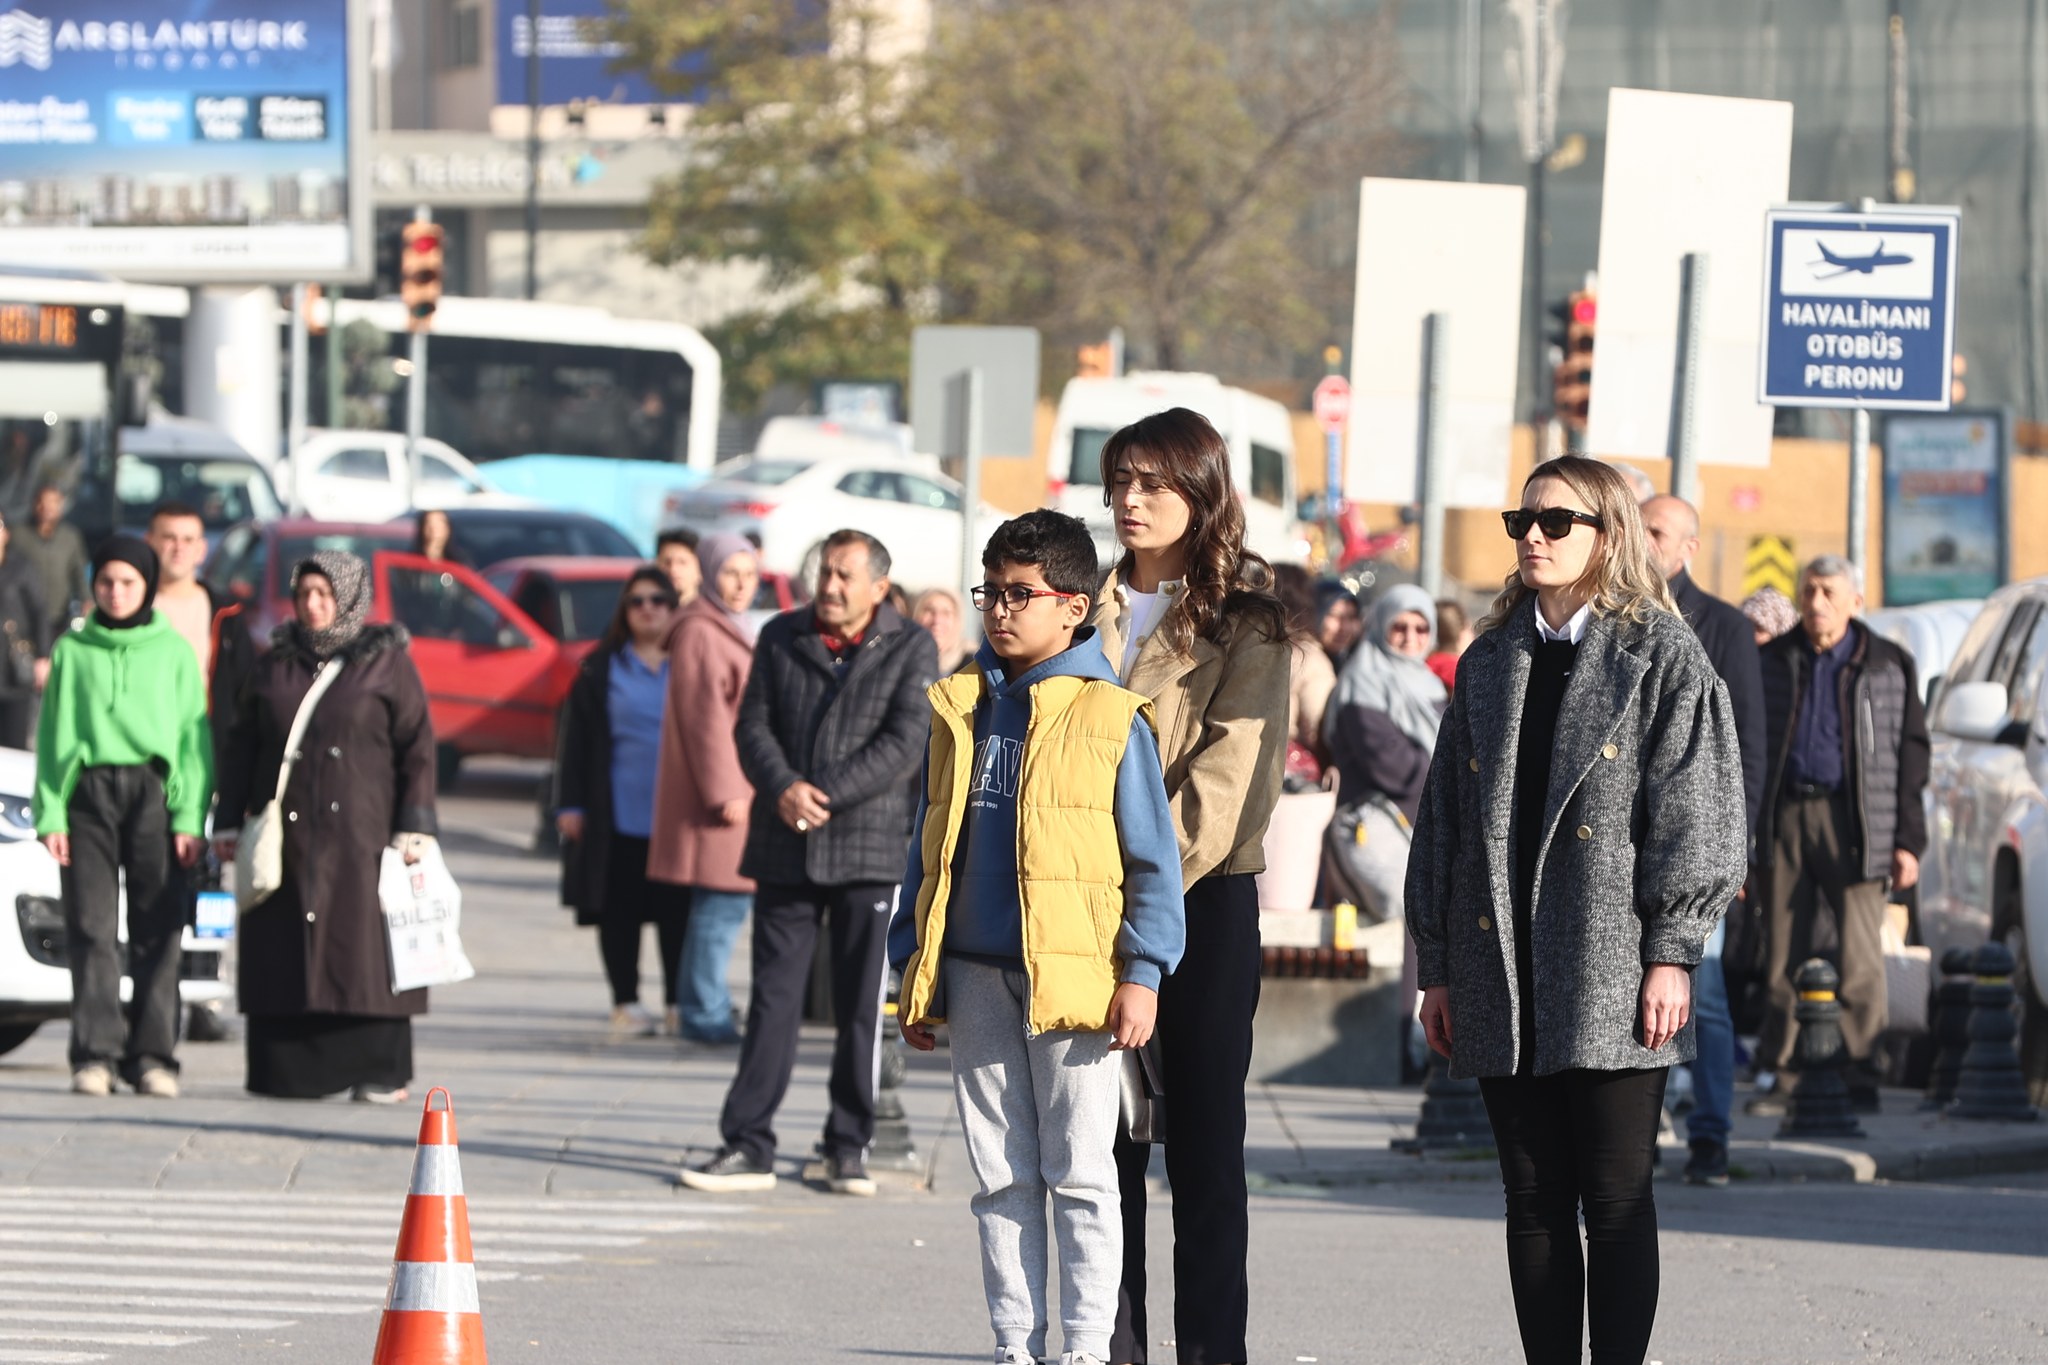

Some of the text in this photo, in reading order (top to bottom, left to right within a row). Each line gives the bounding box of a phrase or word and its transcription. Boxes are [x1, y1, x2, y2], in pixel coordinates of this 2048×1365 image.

[1782, 300, 1931, 330] HAVALİMANI
[1807, 331, 1903, 360] OTOBÜS
[1804, 365, 1904, 391] PERONU
